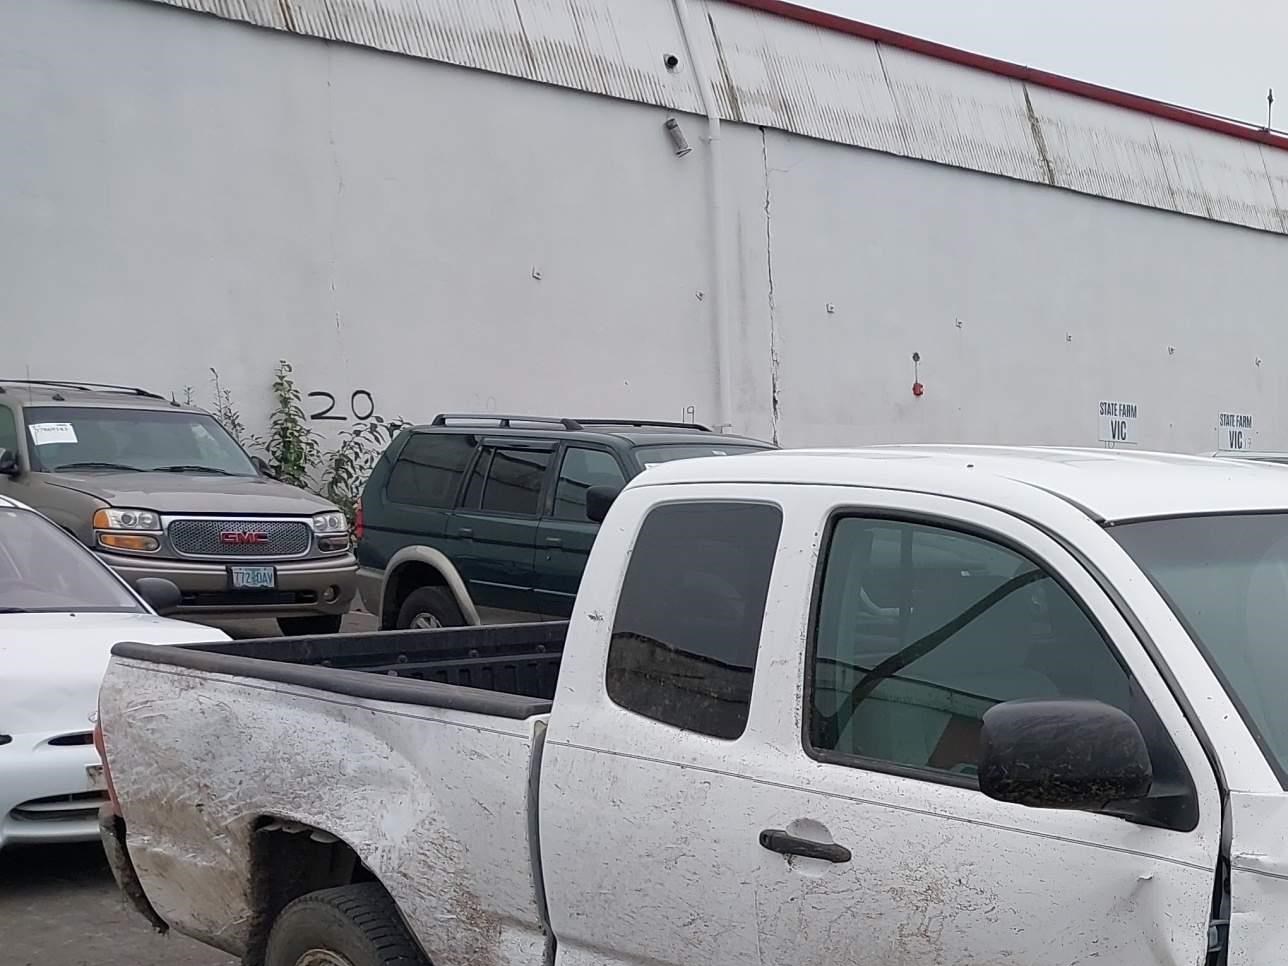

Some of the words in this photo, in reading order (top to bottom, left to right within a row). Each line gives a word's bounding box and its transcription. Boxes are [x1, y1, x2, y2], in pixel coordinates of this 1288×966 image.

[307, 389, 375, 421] 20
[1099, 401, 1118, 417] STATE
[1118, 403, 1137, 419] FARM
[1110, 419, 1127, 441] VIC
[1219, 413, 1236, 428] STATE
[1236, 414, 1252, 429] FARM
[1229, 430, 1243, 449] VIC
[220, 531, 269, 544] GMC
